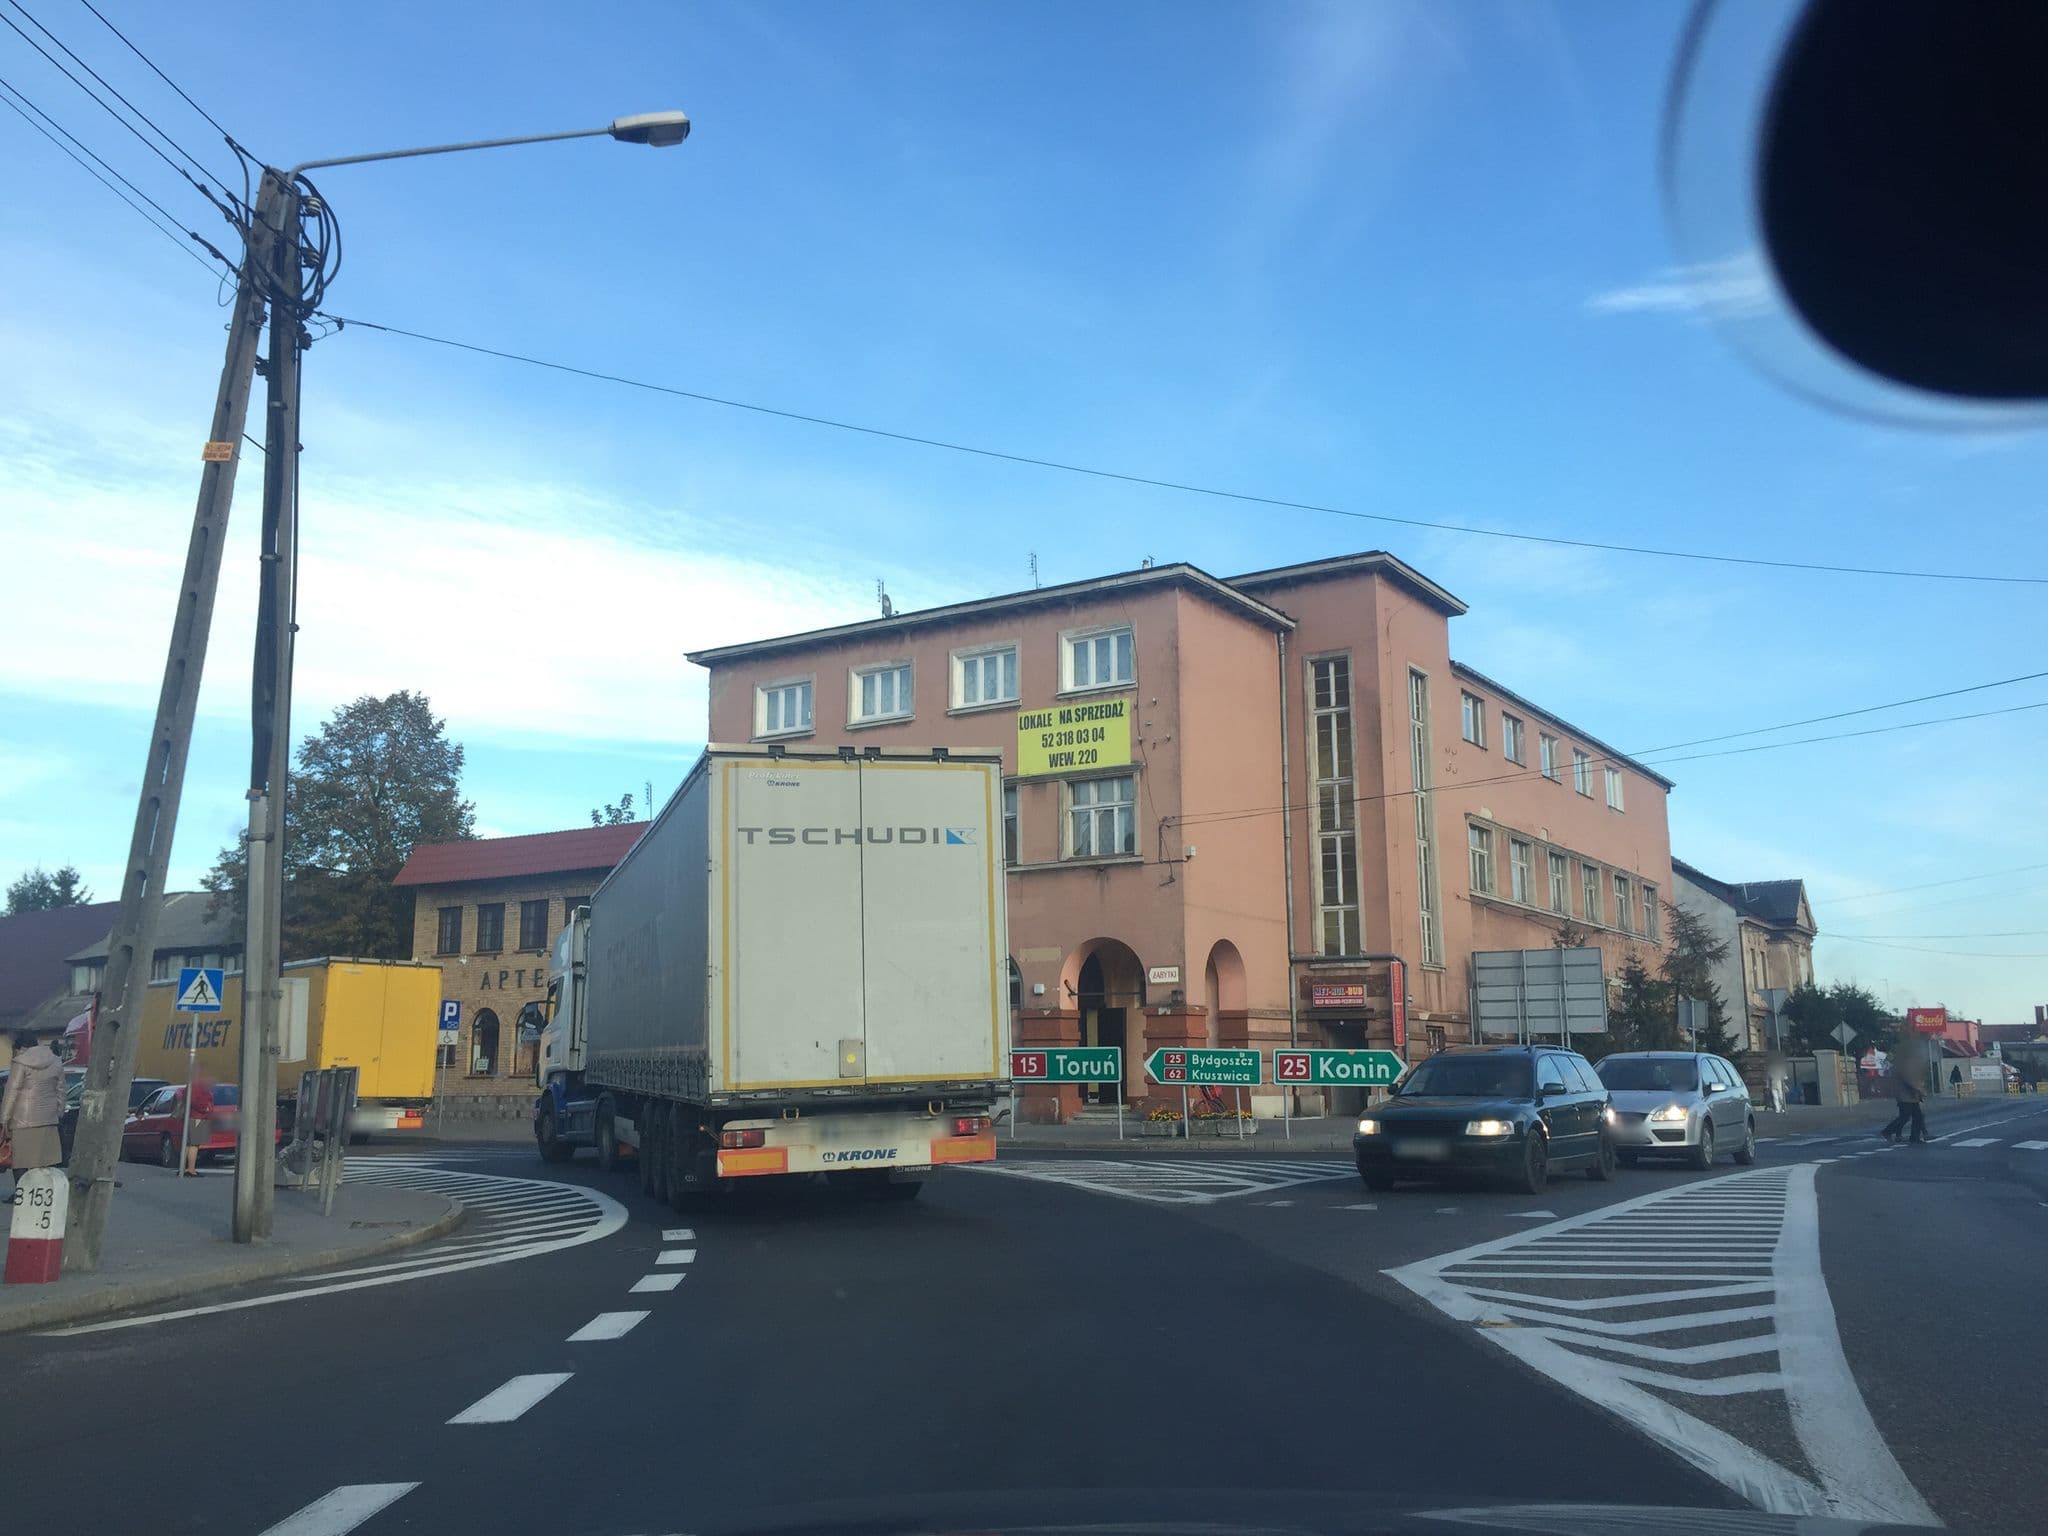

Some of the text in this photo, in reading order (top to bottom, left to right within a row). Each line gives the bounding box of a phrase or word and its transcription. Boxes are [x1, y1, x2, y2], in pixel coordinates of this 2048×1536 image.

[1019, 700, 1124, 730] LOKALE NA SPRZEDAŻ
[1042, 727, 1105, 748] 52 318 03 04
[1048, 749, 1098, 768] WEW. 220
[738, 827, 939, 845] TSCHUDI
[480, 968, 544, 990] APTE
[444, 1002, 457, 1021] P
[1020, 1057, 1037, 1073] 15
[1055, 1054, 1115, 1076] Toruń
[1169, 1054, 1253, 1068] 25 Bydgoszcz
[1283, 1057, 1389, 1079] 25 Konin
[1169, 1069, 1250, 1081] 62 Kruszwica
[837, 1148, 898, 1161] KRONE
[28, 1188, 54, 1207] 153
